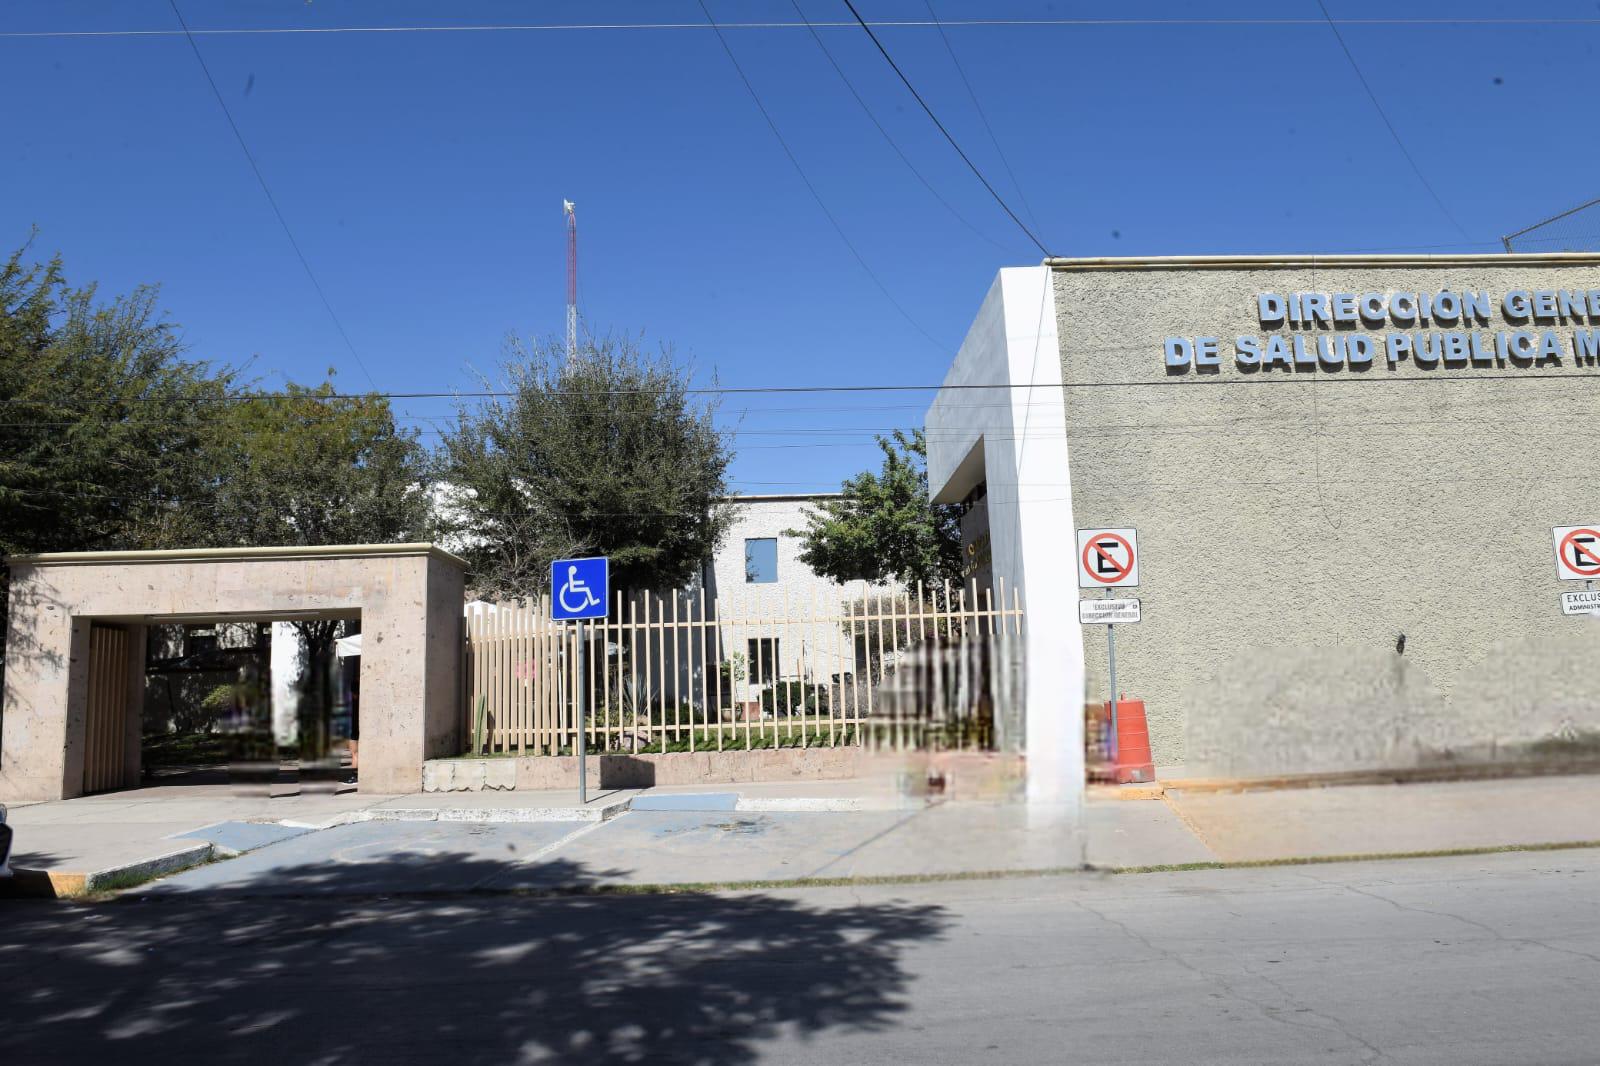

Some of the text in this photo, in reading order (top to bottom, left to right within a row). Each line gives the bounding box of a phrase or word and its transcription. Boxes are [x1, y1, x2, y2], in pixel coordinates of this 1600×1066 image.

[1258, 285, 1600, 321] DIRECCIÓN GENE
[1164, 328, 1600, 366] DE SALUD PUBLICA M
[1096, 542, 1121, 573] E
